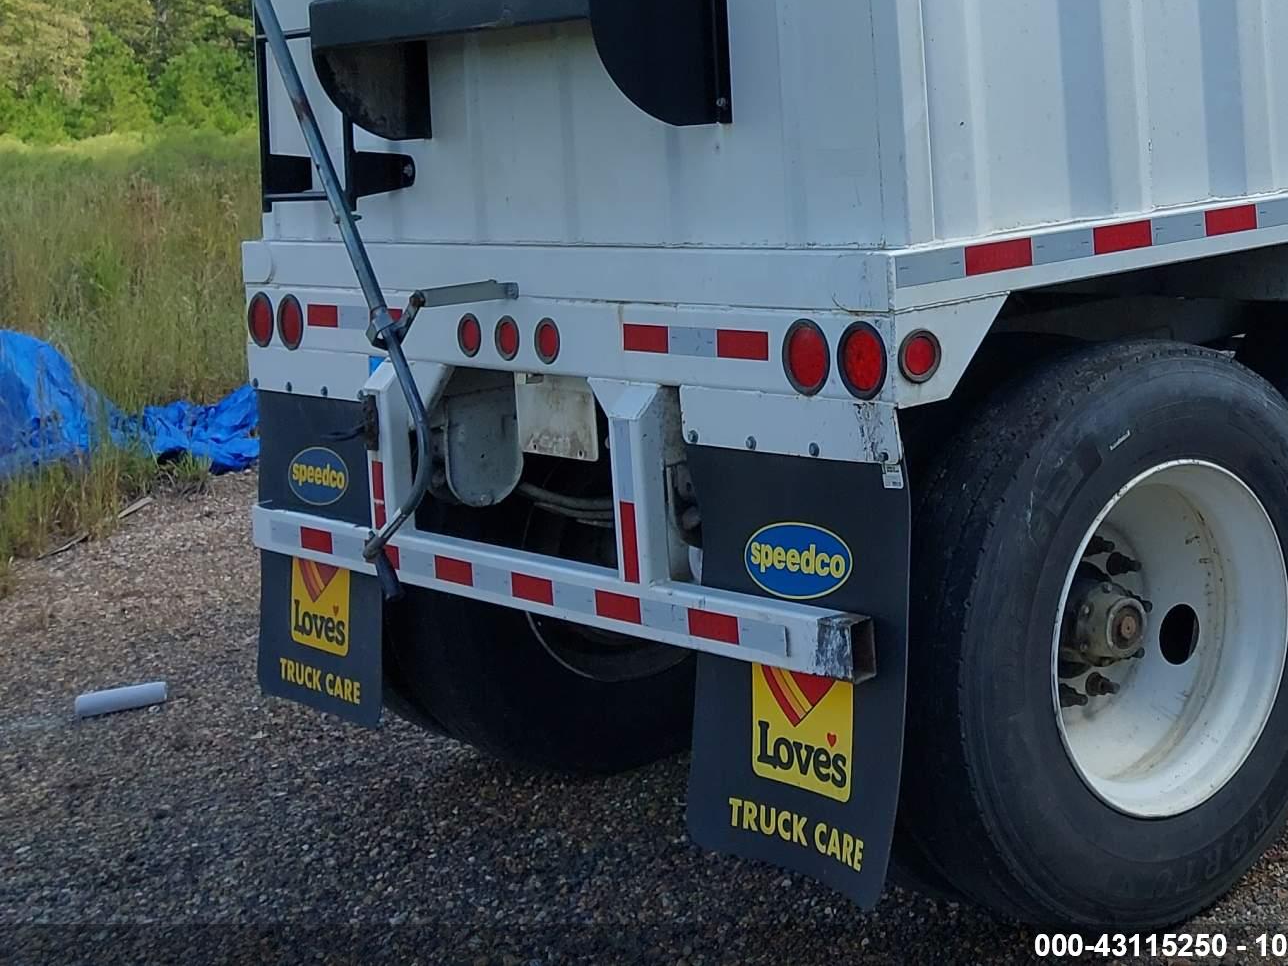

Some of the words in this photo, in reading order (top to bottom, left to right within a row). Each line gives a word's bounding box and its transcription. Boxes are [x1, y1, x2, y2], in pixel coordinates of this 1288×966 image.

[292, 461, 345, 489] speedco
[750, 540, 845, 579] speedco
[279, 656, 322, 691] TRUCK
[325, 671, 361, 705] CARE
[728, 796, 808, 847] TRUCK
[814, 821, 864, 873] CARE
